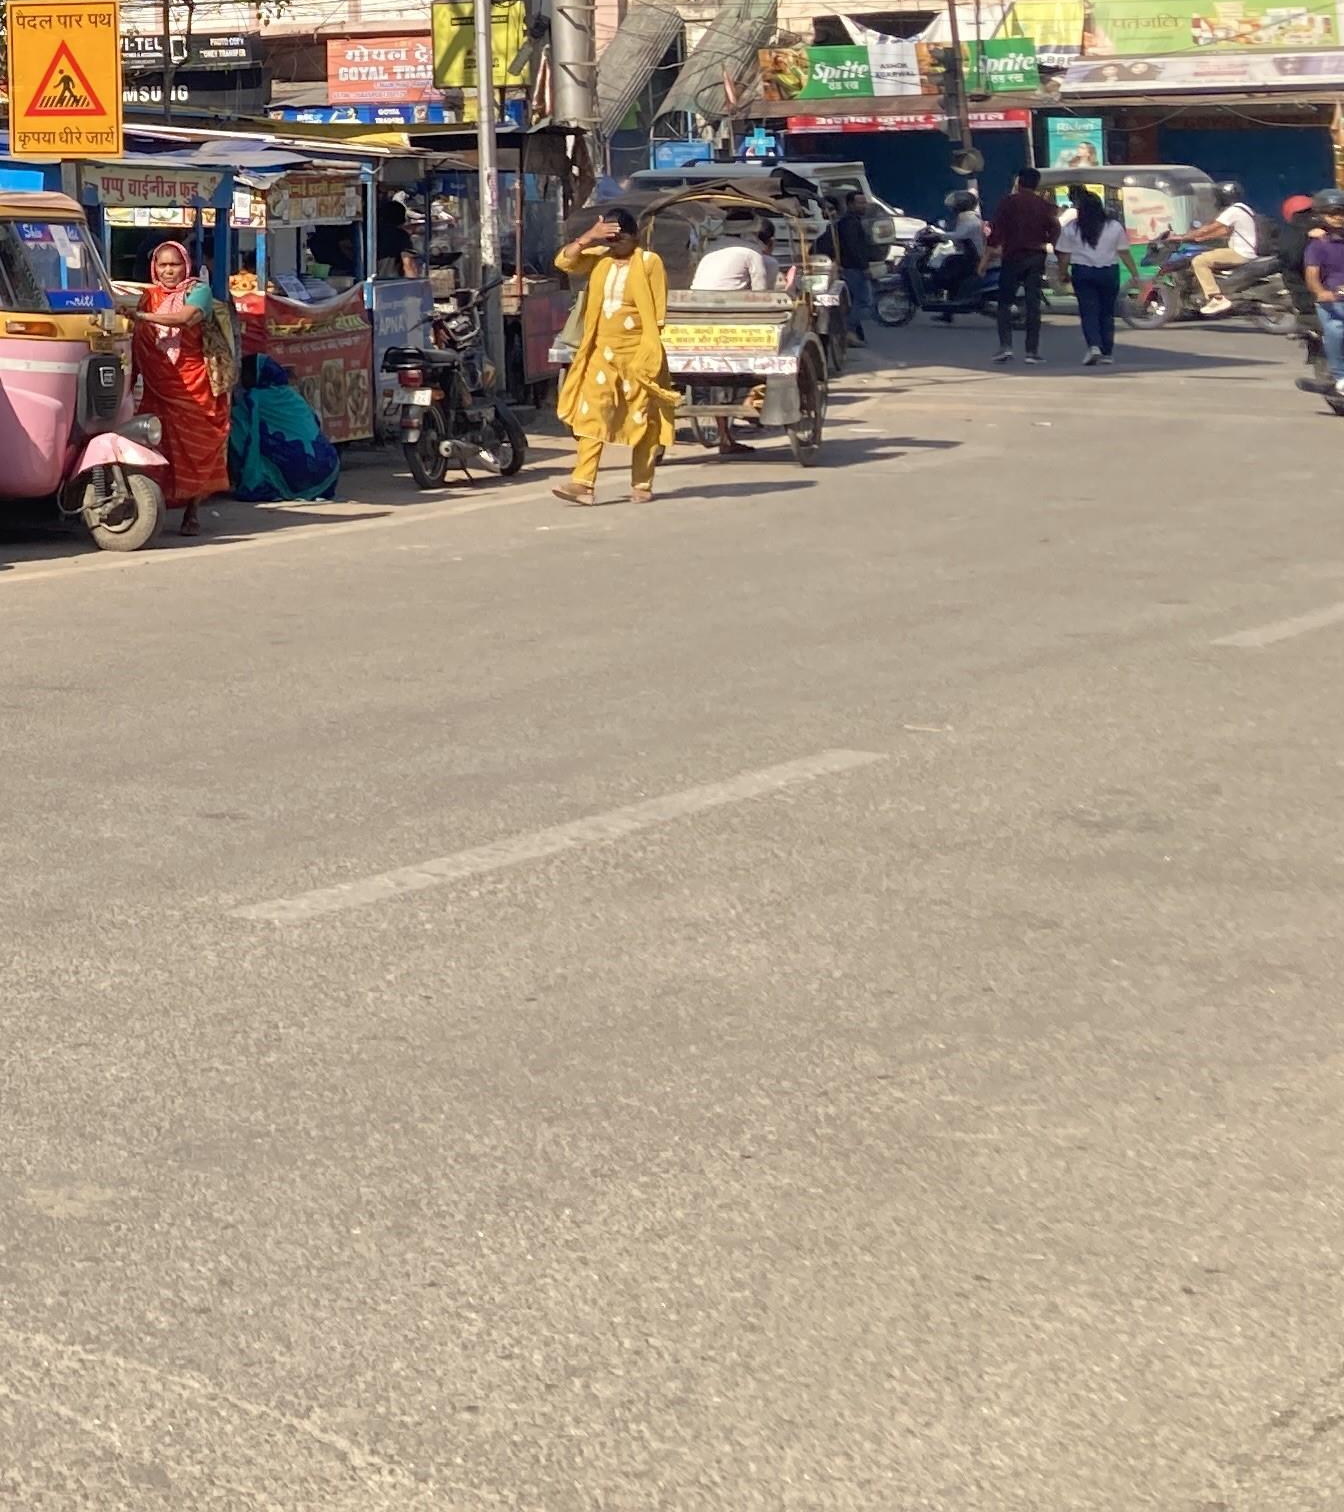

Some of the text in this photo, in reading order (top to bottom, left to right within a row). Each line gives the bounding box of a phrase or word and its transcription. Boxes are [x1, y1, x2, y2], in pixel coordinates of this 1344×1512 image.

[16, 10, 112, 30] पैदल पार पथ
[344, 44, 409, 62] गोयल
[338, 66, 388, 81] GOYAL
[812, 60, 870, 80] Sprite
[17, 131, 56, 149] कृपया
[59, 126, 82, 145] धीरे
